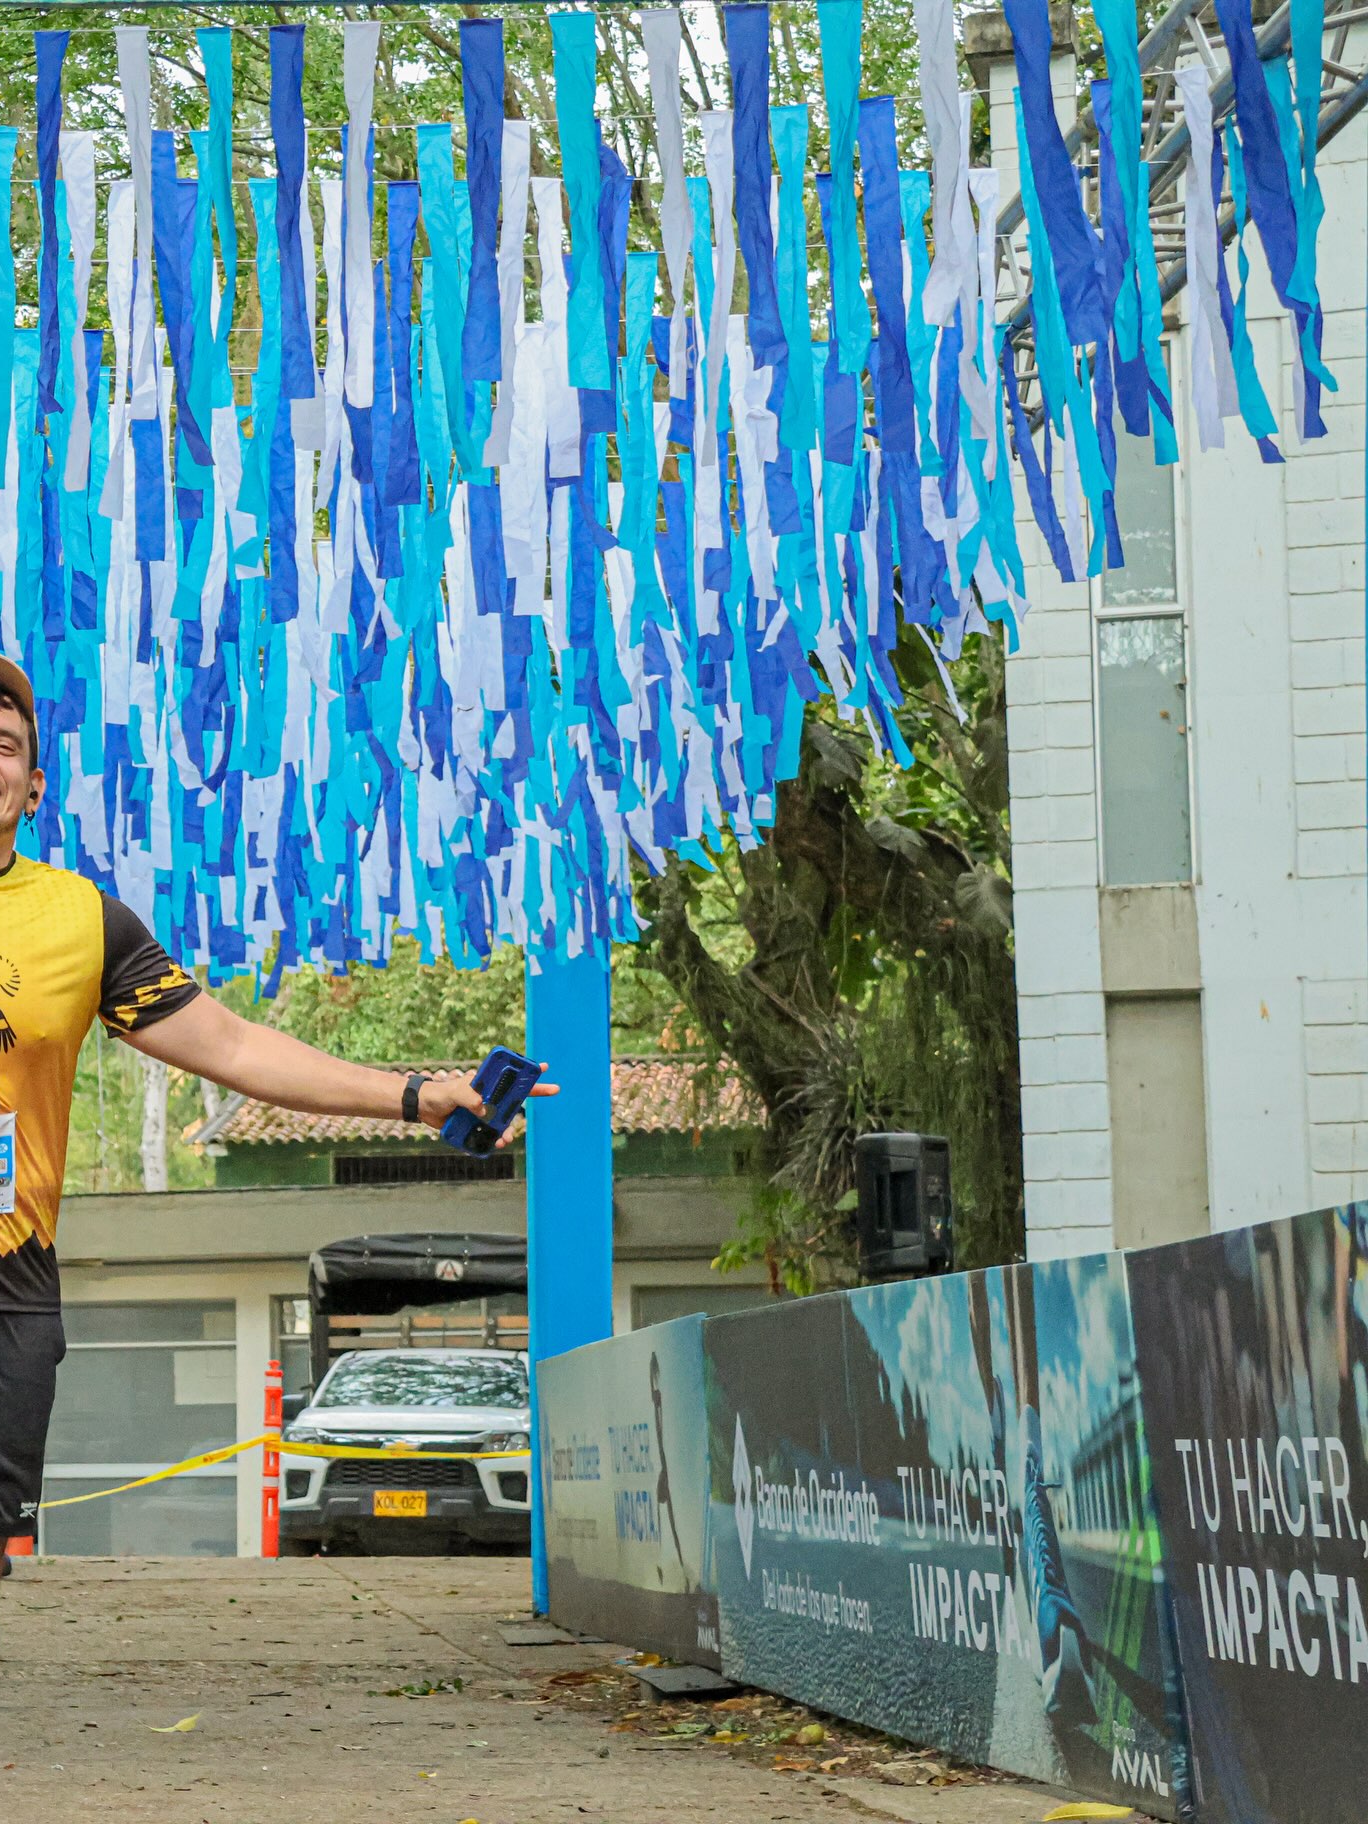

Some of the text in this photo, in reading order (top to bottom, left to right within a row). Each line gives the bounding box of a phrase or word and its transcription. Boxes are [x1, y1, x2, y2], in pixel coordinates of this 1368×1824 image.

[401, 1496, 424, 1509] 027
[755, 1465, 881, 1547] Banco de Occidente
[896, 1466, 1020, 1551] TU HACER,
[1175, 1435, 1368, 1559] TU HACER,
[762, 1568, 777, 1610] Del
[777, 1568, 795, 1615] lado
[795, 1572, 806, 1617] de
[806, 1574, 820, 1621] los
[822, 1592, 839, 1635] que
[909, 1562, 1032, 1660] IMPACTA.
[1197, 1562, 1368, 1684] IMPACTA
[1111, 1744, 1169, 1798] AVAL
